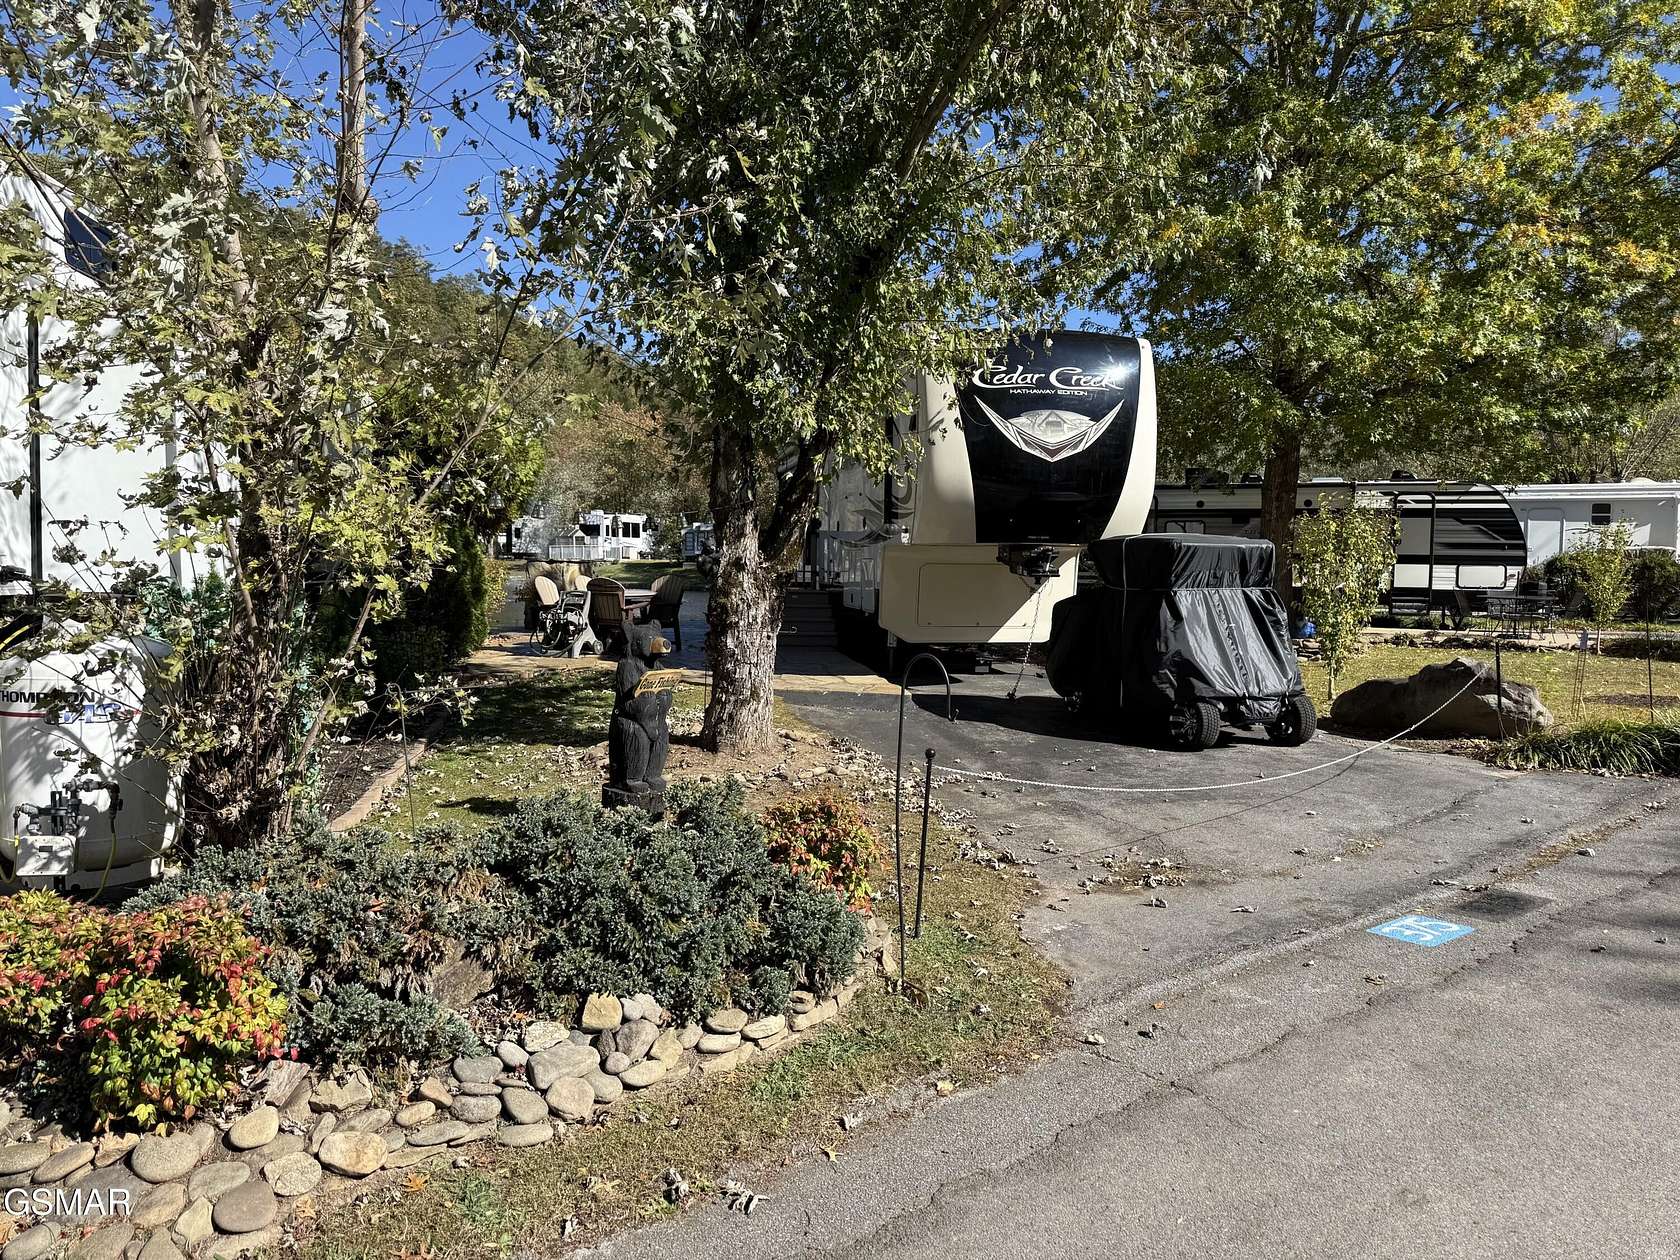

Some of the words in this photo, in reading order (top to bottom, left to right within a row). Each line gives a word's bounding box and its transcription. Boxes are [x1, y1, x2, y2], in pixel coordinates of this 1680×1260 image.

[972, 364, 1046, 389] Cedar
[1048, 366, 1124, 391] Creek
[1380, 917, 1461, 941] 375
